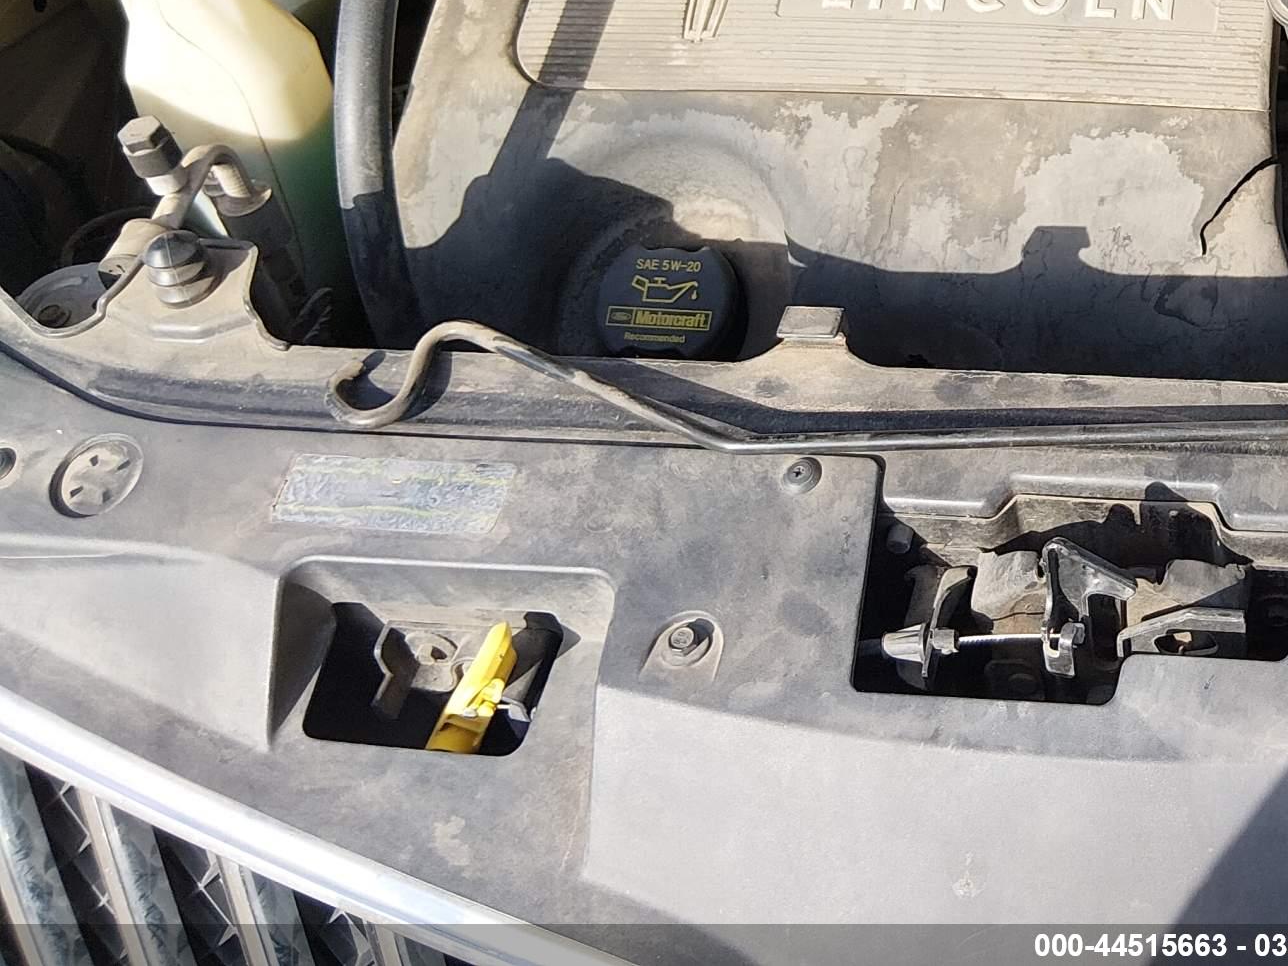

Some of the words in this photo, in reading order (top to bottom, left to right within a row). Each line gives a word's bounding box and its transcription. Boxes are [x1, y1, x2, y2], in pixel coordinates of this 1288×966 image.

[636, 259, 659, 270] SAE
[662, 260, 701, 272] 5W-20
[635, 310, 706, 328] Motorcraft
[624, 332, 684, 343] Recommended
